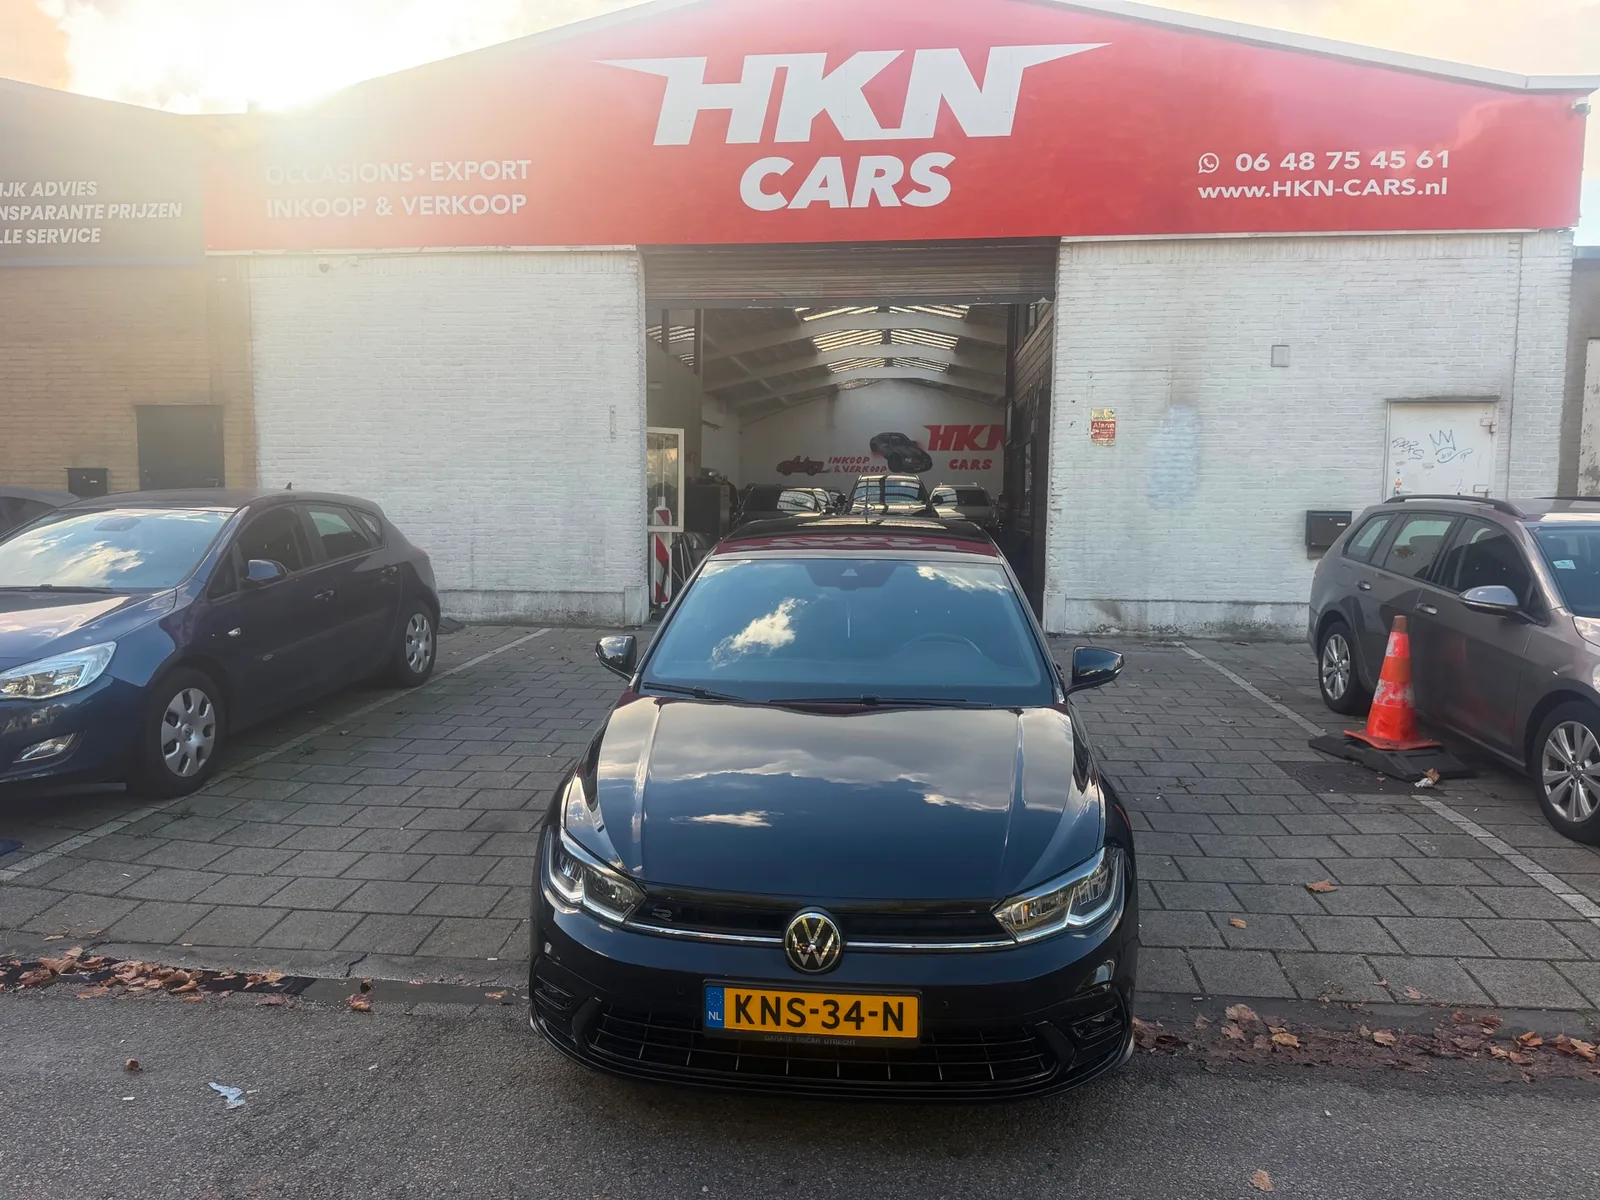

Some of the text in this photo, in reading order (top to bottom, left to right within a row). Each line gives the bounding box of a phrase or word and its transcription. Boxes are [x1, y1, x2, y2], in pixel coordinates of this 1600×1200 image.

[593, 42, 1113, 146] HKN
[430, 159, 532, 182] EXPORT
[1235, 150, 1449, 172] 06 48 75 45 61
[31, 181, 98, 197] ADVIES
[739, 152, 956, 211] CARS
[1197, 177, 1448, 199] www.HKN-CARS.nl
[108, 202, 183, 219] PRIJZEN
[267, 194, 527, 219] INKOOP & VERKOOP
[25, 228, 101, 244] SERVICE
[828, 456, 870, 464] INKOOP
[842, 465, 887, 473] VERKOOP
[948, 458, 993, 470] CARS
[708, 1011, 722, 1021] NL
[734, 993, 904, 1032] KNS-34-N
